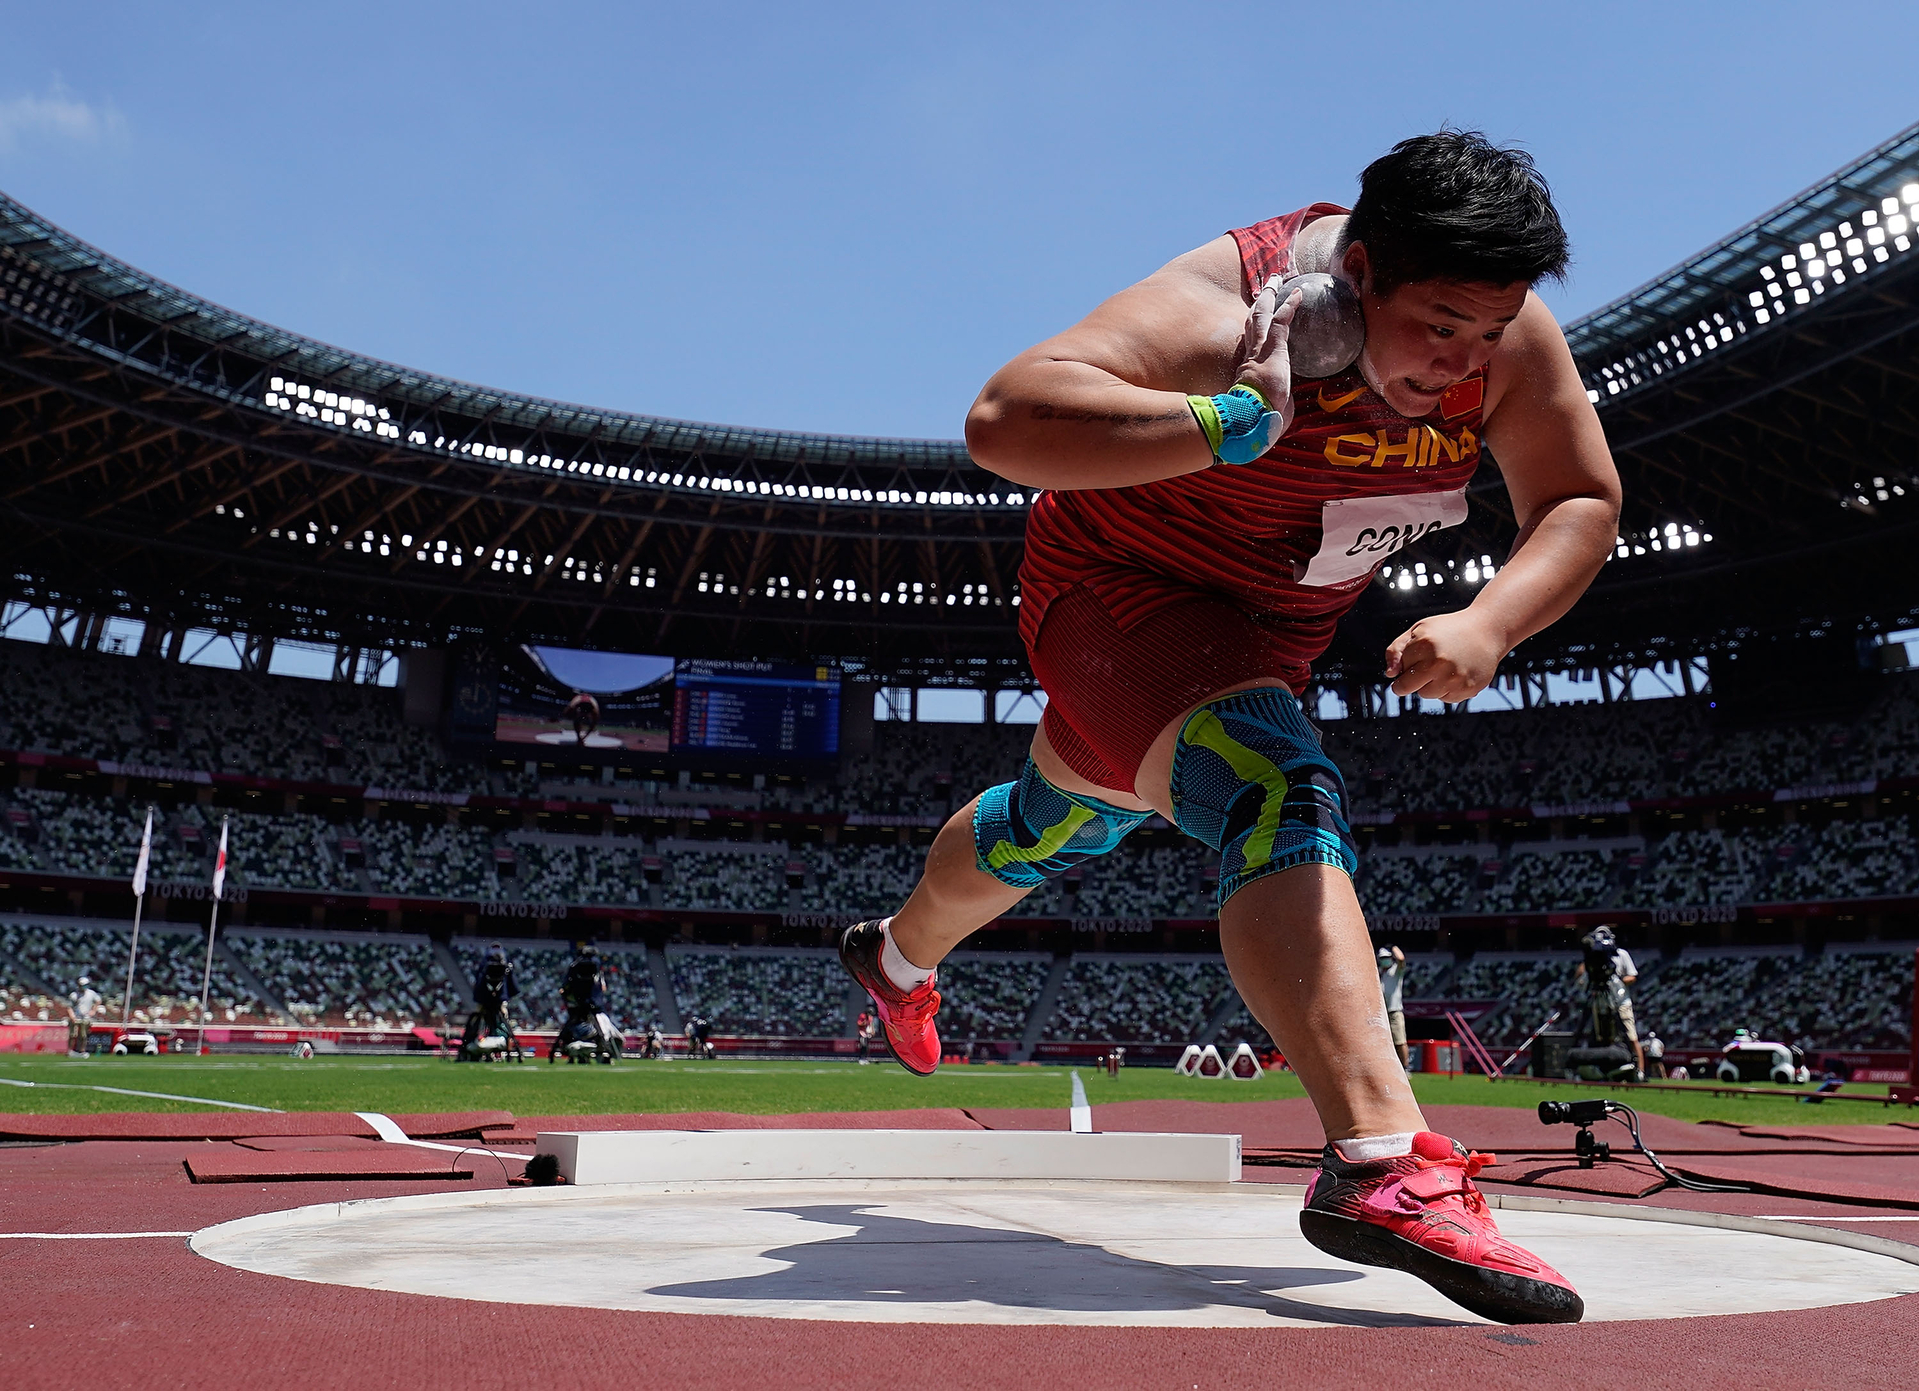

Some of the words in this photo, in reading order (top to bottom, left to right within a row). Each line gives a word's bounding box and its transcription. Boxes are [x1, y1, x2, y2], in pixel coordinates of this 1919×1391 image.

[1324, 426, 1478, 467] CHINA
[691, 658, 732, 670] WOMEN'S
[151, 883, 205, 901] TOKYO
[480, 902, 528, 918] TOKYO
[530, 905, 568, 920] 2020
[1650, 908, 1699, 926] TOKYO
[1700, 906, 1739, 924] 2020
[781, 912, 828, 928] TOKYO
[1071, 918, 1117, 933] TOKYO
[1118, 918, 1154, 934] 2020
[1405, 916, 1440, 932] 2020
